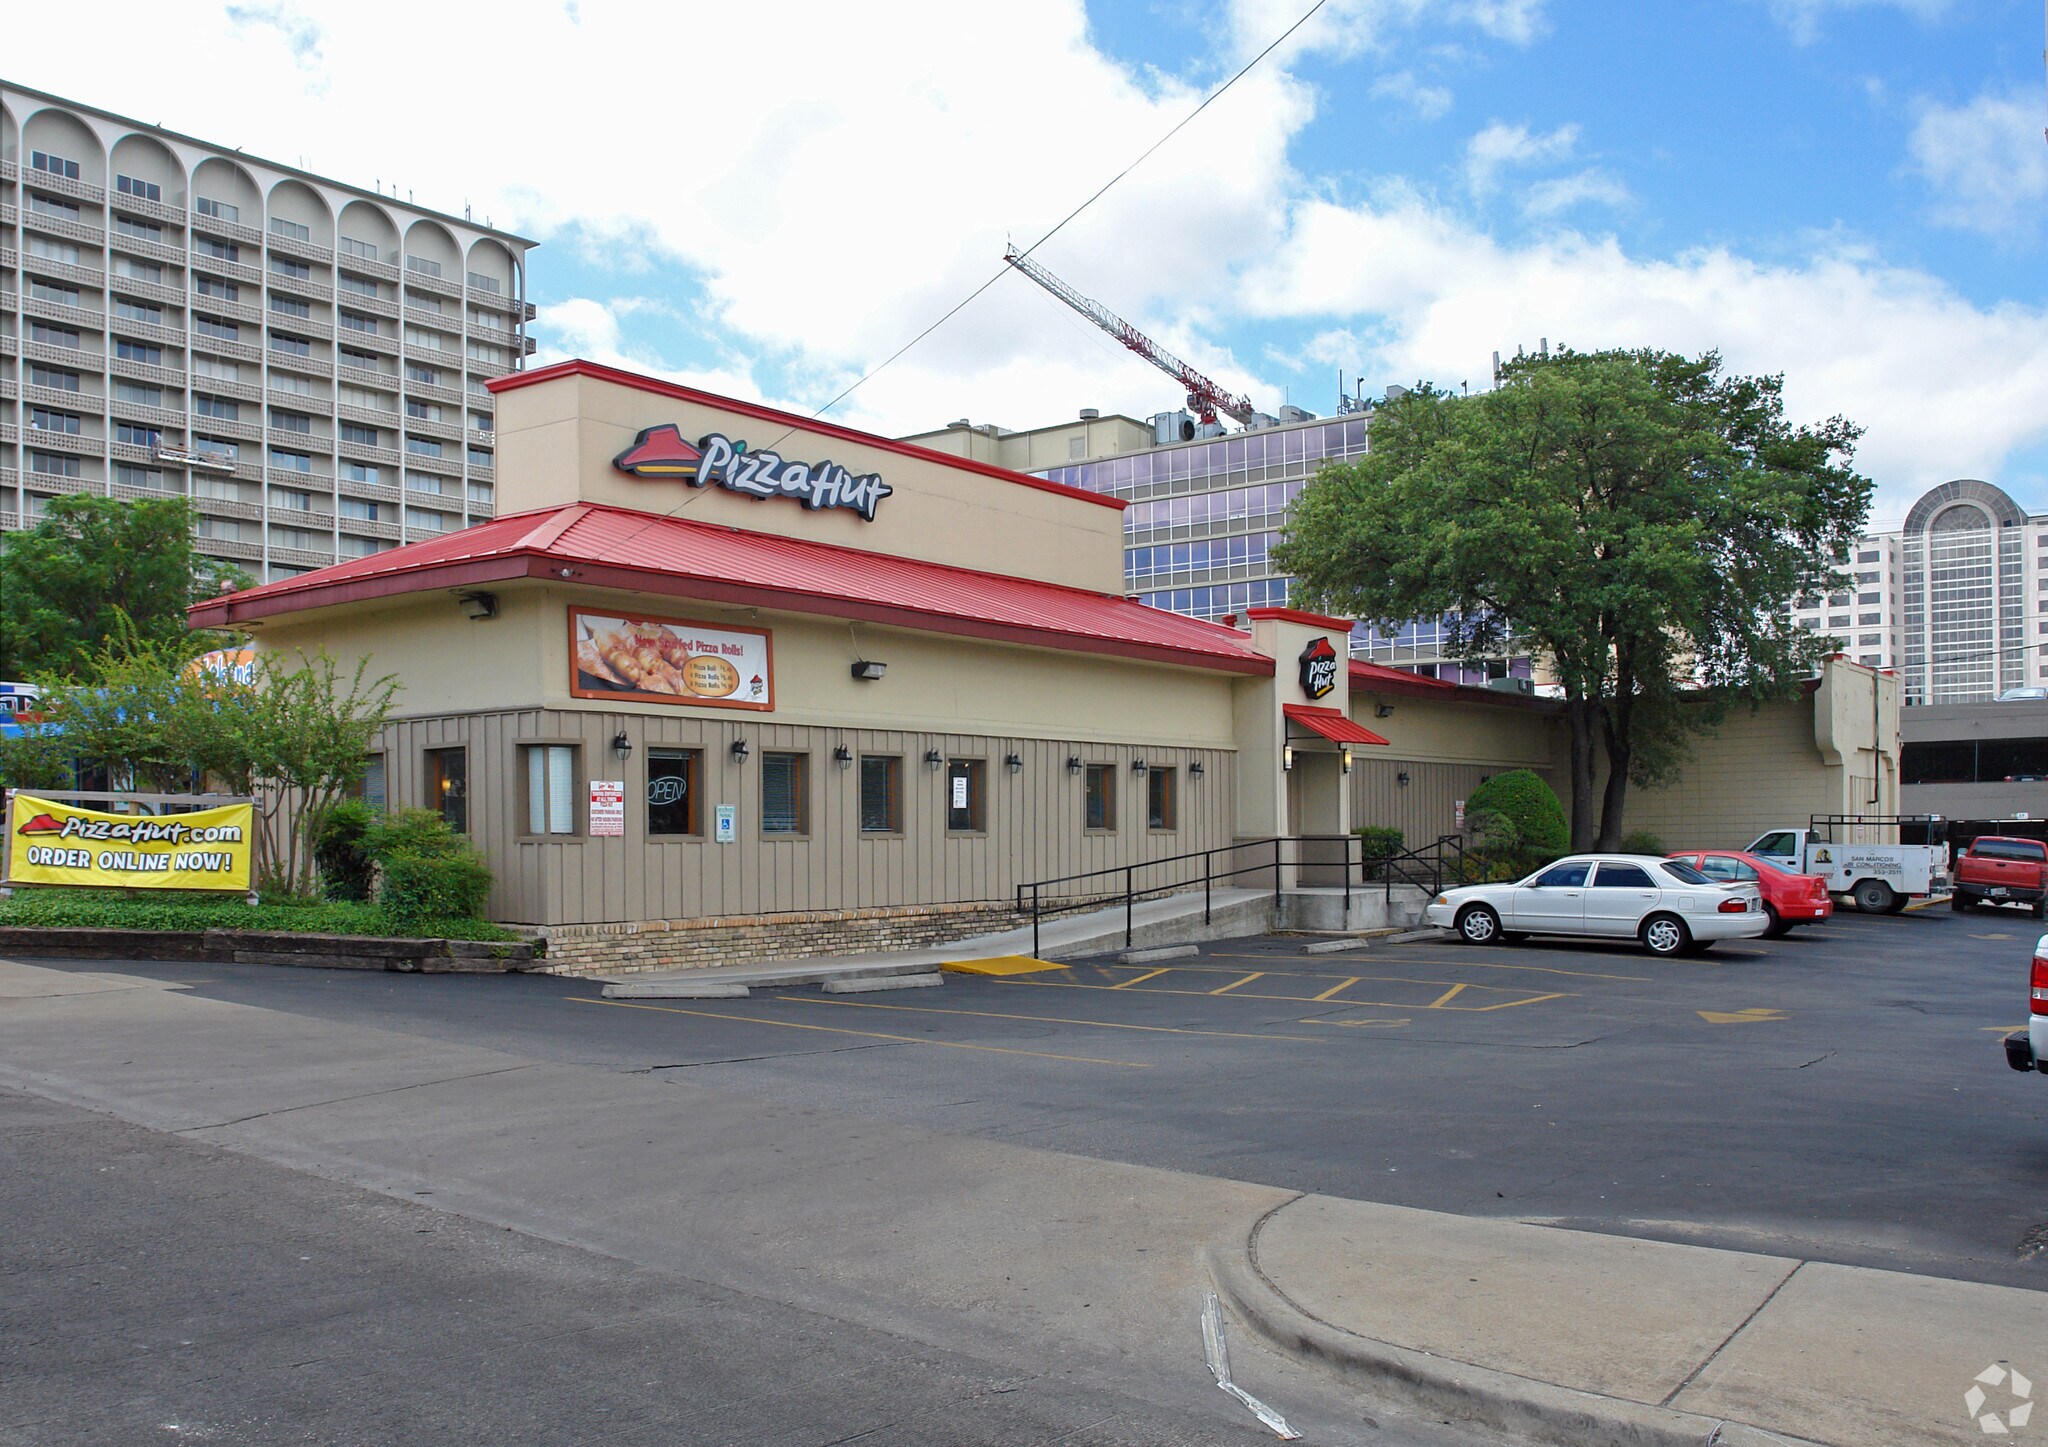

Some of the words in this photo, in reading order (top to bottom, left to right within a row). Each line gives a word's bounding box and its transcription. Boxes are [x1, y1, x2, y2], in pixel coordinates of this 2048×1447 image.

[699, 436, 810, 494] Pizza
[810, 463, 892, 518] Hut
[696, 641, 718, 653] Pizza
[722, 643, 744, 656] Rolls!
[1309, 660, 1336, 684] Pizza
[1313, 672, 1332, 692] Hut
[648, 781, 684, 800] OPEN
[27, 846, 91, 867] ORDER
[98, 850, 169, 871] ONLINE
[175, 852, 232, 871] NOW!
